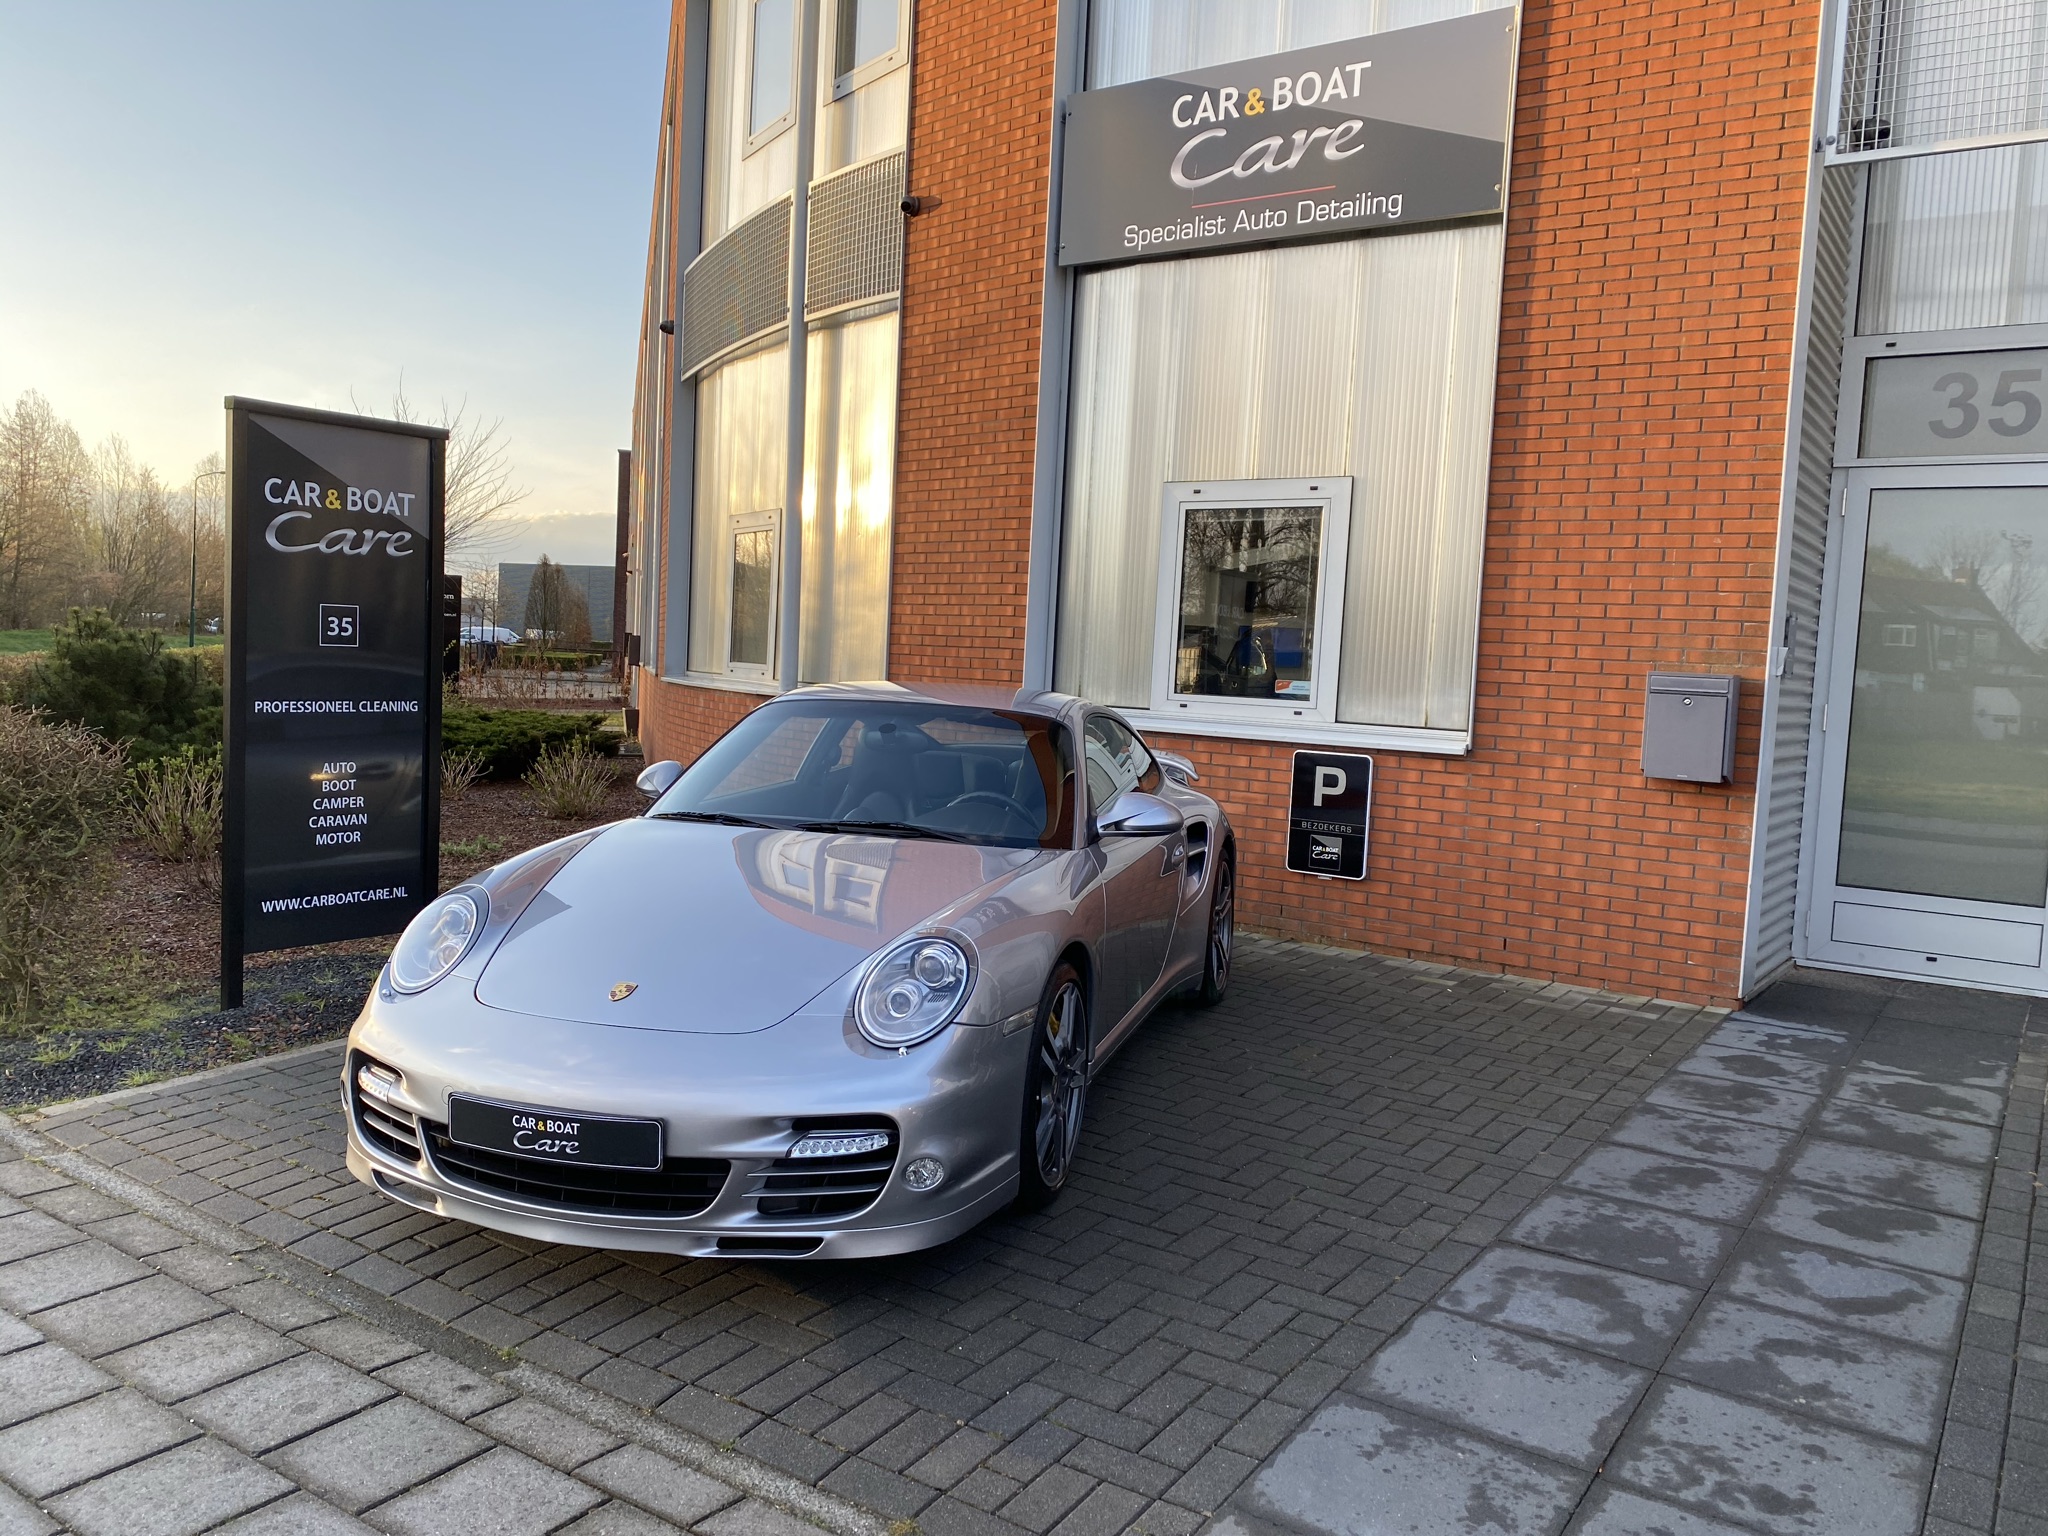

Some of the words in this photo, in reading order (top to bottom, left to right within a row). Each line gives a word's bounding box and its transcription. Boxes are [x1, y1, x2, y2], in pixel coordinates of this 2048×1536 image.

[1169, 118, 1365, 189] Care
[1123, 214, 1226, 251] Specialist
[1233, 207, 1288, 234] Auto
[1296, 192, 1404, 226] Detailing
[1927, 368, 2043, 439] 35
[265, 510, 414, 557] Care
[326, 616, 354, 637] 35
[254, 700, 356, 713] PROFESSIONEEL
[358, 700, 419, 713] CLEANING
[322, 761, 357, 774] AUTO
[321, 779, 357, 792] BOOT
[1313, 765, 1347, 807] P
[312, 796, 365, 810] CAMPER
[308, 813, 368, 828] CARAVAN
[1301, 821, 1352, 834] BEZOEKERS
[315, 831, 362, 846] MOTOR
[261, 886, 409, 913] WWW.CARBOATCARE.NL
[512, 1130, 581, 1155] Care
